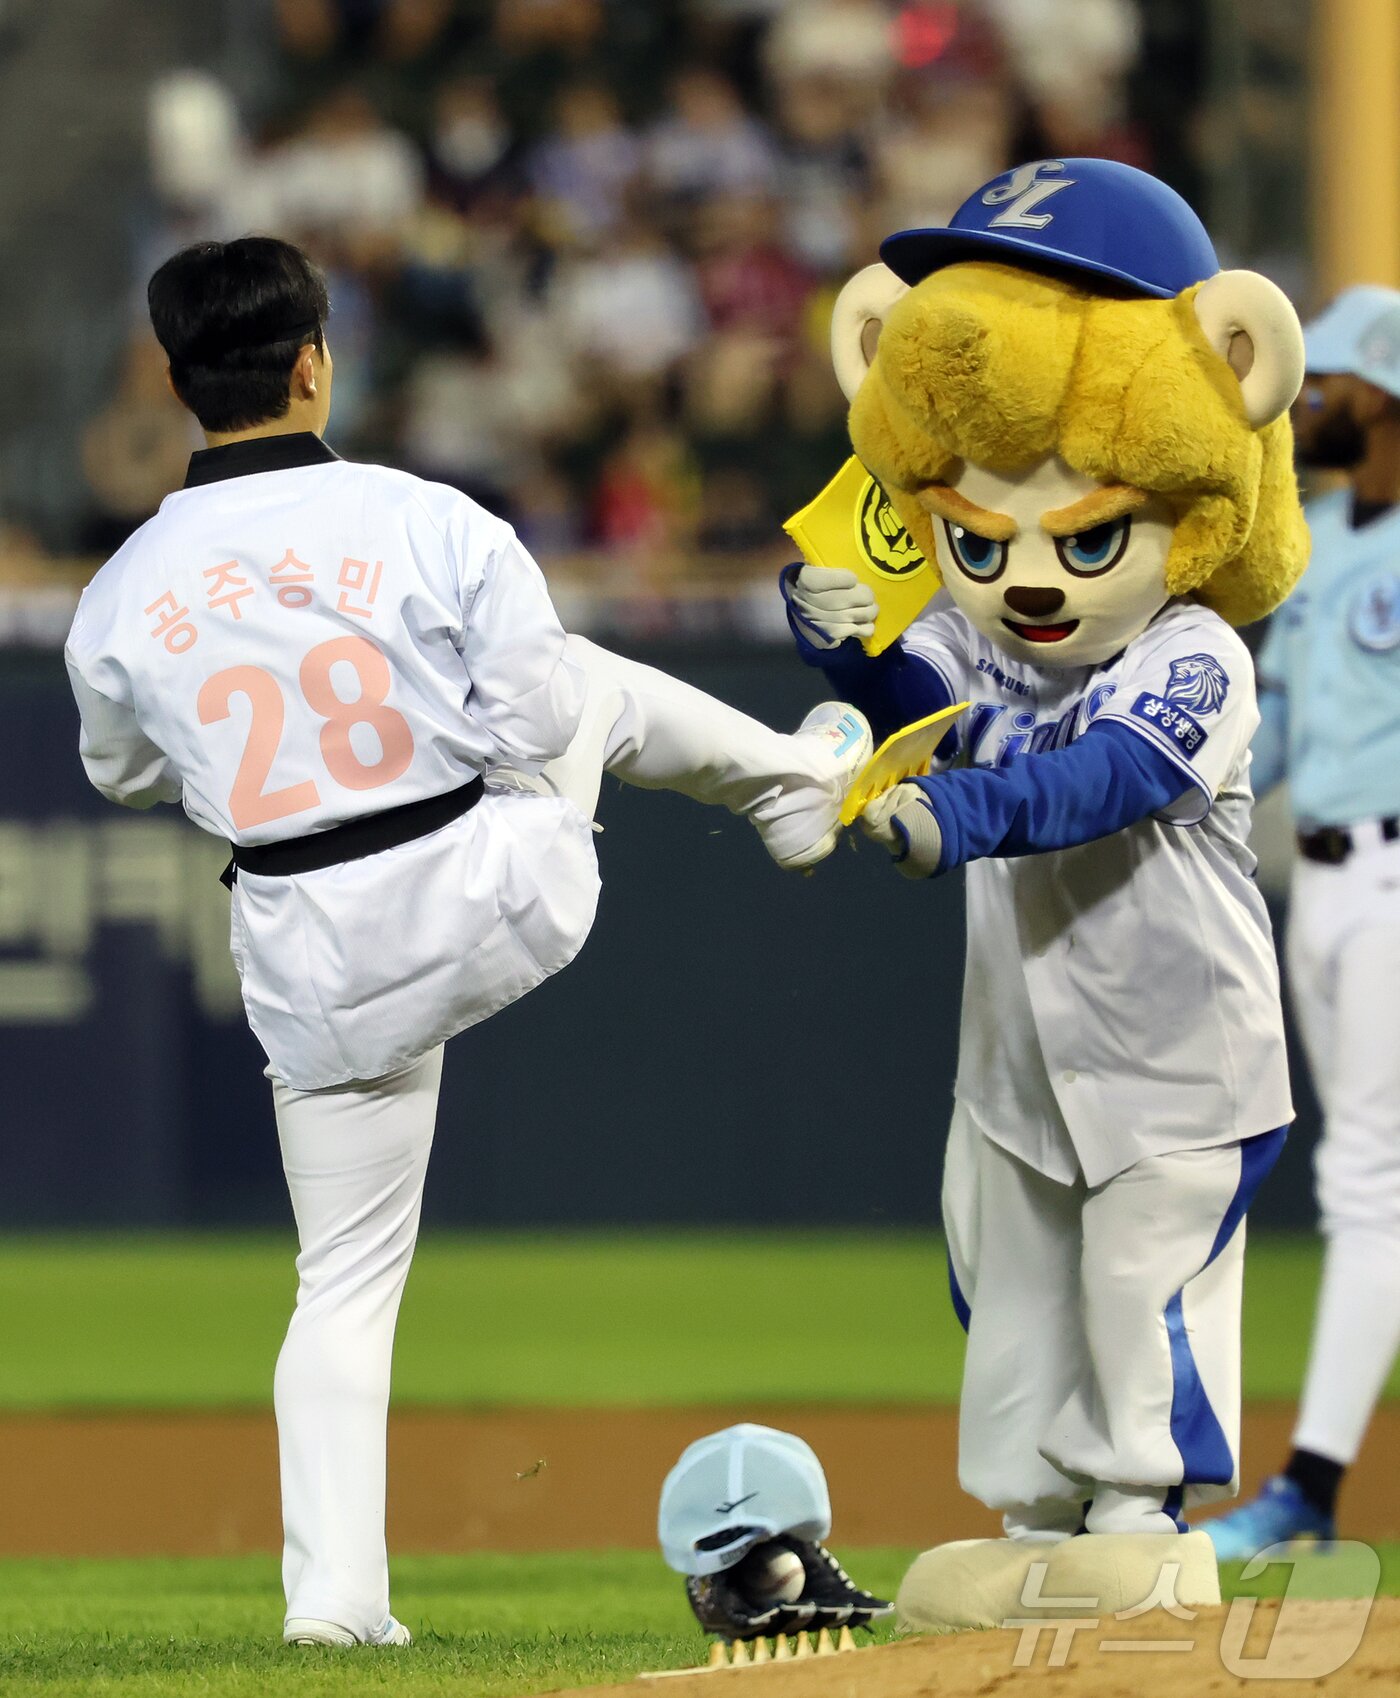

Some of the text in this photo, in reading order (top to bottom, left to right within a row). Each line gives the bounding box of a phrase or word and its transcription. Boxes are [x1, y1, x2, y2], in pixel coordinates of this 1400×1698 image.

[144, 548, 383, 654] 공주승민
[975, 658, 1030, 696] SAMSUNG
[197, 635, 414, 831] 28
[1143, 698, 1202, 750] 삼성생명
